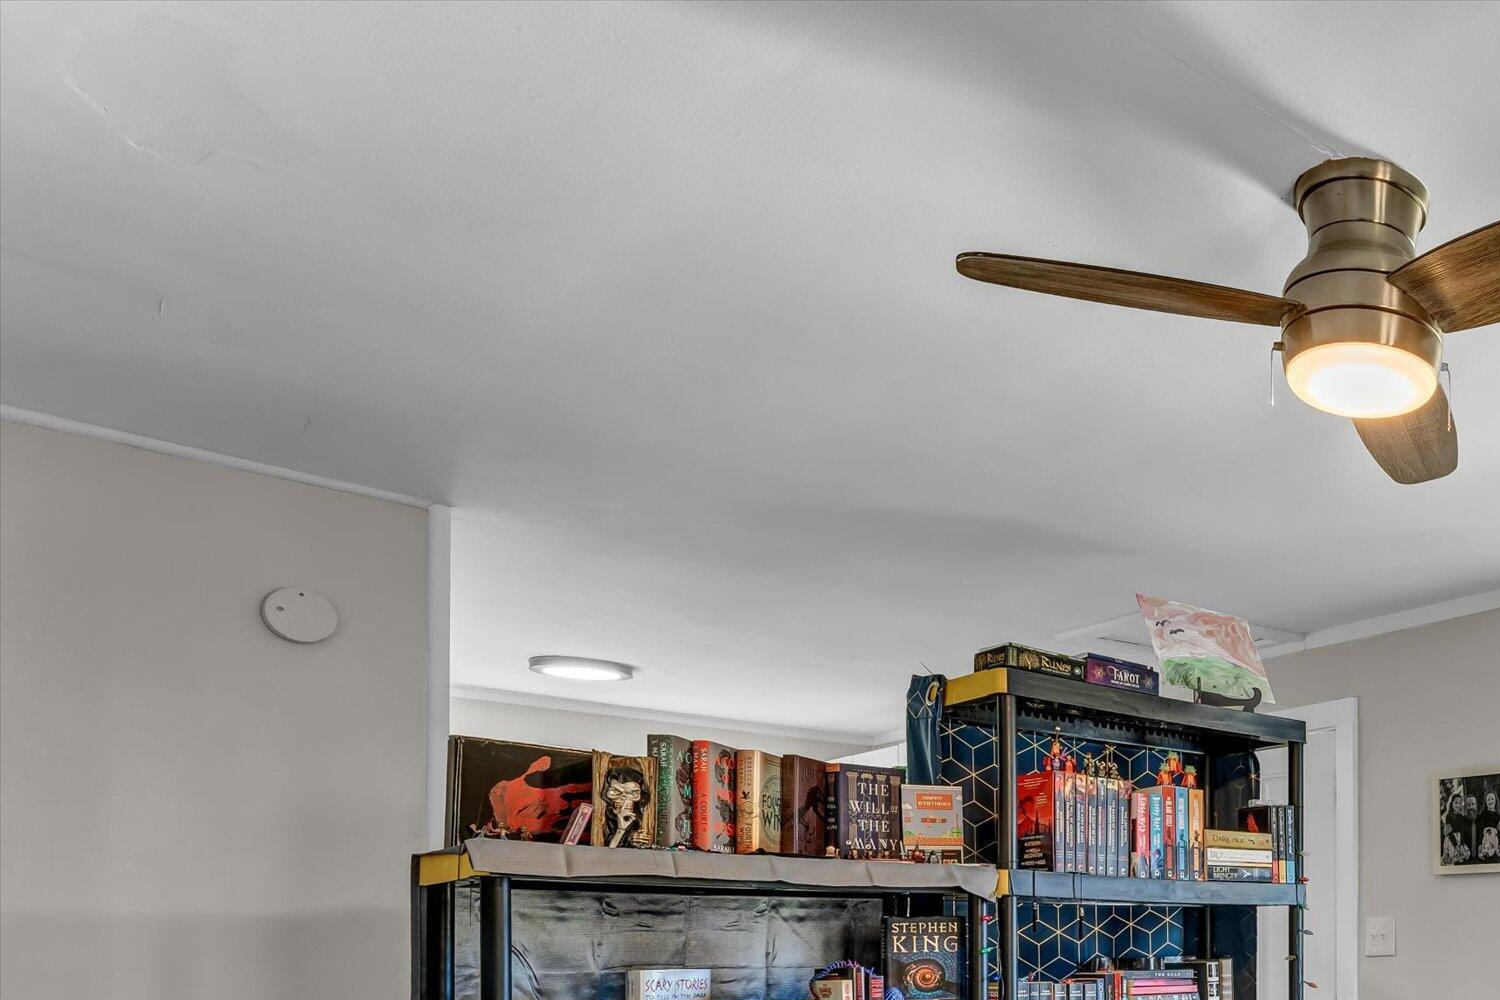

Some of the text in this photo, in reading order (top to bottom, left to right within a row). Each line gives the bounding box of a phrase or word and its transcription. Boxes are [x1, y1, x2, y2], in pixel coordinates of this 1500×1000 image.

[858, 782, 890, 797] THE
[849, 800, 889, 815] WILL
[858, 820, 890, 833] THE
[850, 839, 898, 850] MANY
[891, 922, 958, 933] STEPHEN
[892, 936, 958, 952] KING
[645, 978, 672, 992] SCARY
[675, 978, 708, 992] STORIES
[871, 979, 883, 998] DEAN
